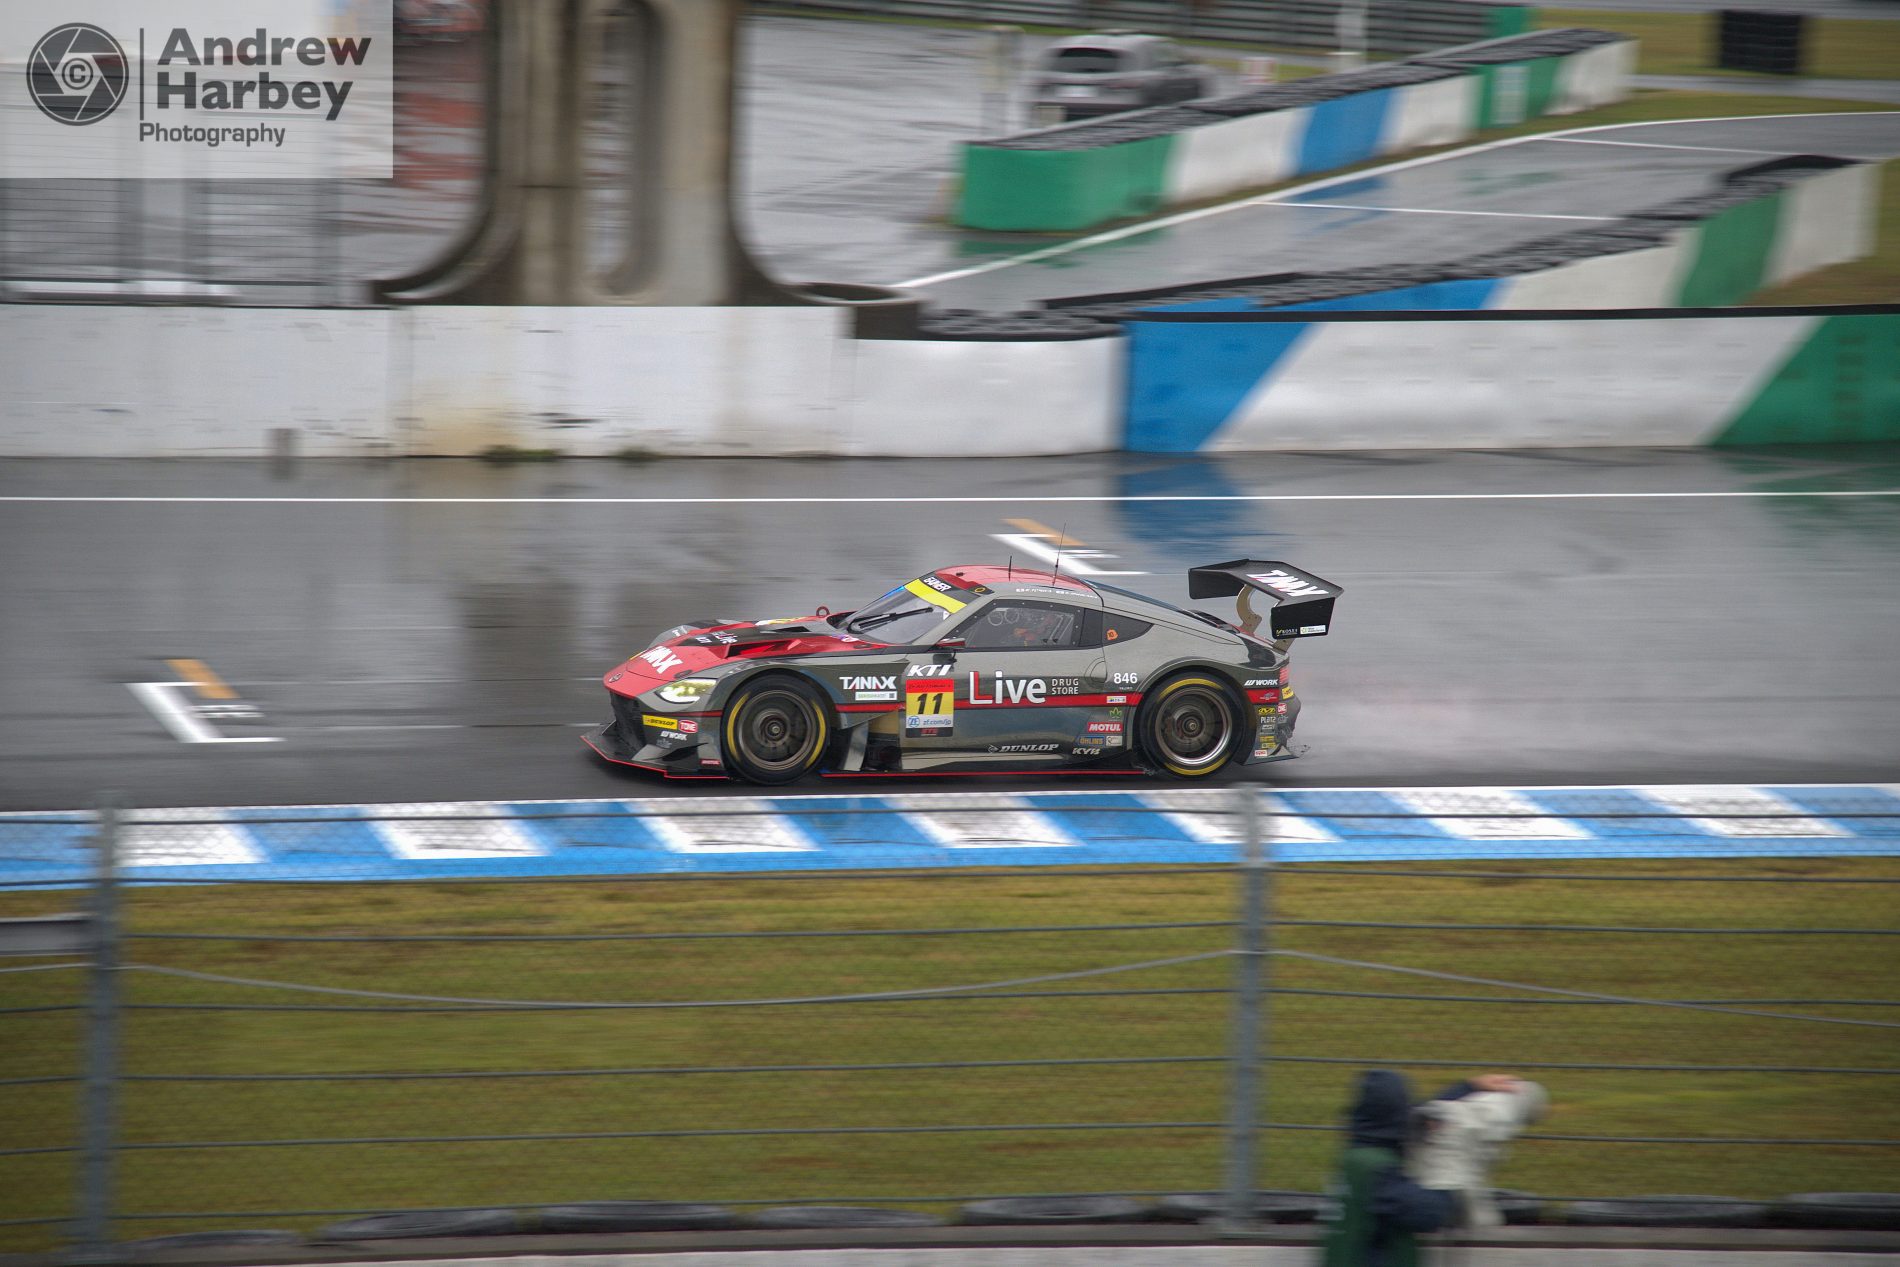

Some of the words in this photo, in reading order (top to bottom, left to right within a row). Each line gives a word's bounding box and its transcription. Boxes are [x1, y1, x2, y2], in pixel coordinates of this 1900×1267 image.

[907, 664, 952, 677] KTI
[839, 676, 897, 690] TANAX
[1051, 678, 1079, 686] DRUG
[1113, 672, 1138, 684] 846
[969, 670, 1047, 704] Live
[1051, 687, 1079, 695] STORE
[917, 692, 944, 715] 11
[1088, 723, 1122, 732] MOTUL
[999, 743, 1060, 753] DUNLOP
